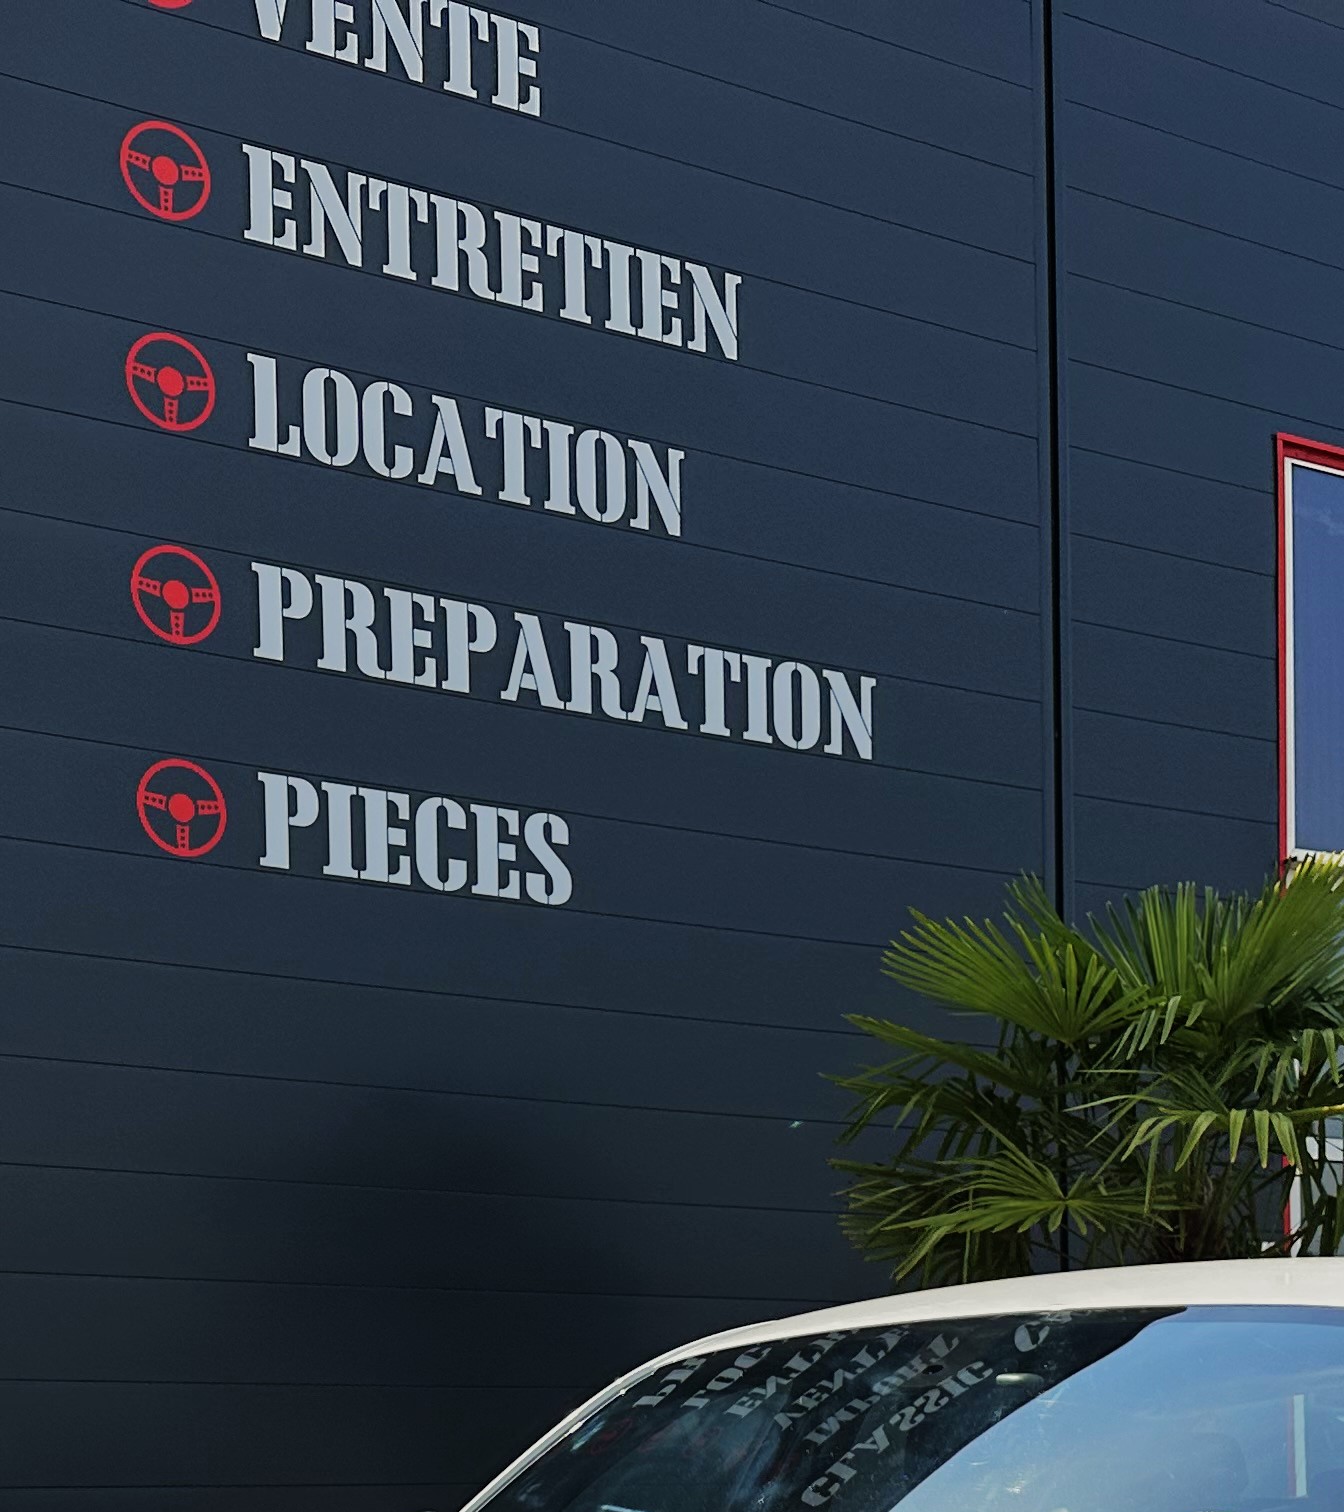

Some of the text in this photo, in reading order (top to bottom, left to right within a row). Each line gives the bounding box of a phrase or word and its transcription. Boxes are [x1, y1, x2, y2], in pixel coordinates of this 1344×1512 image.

[242, 143, 742, 361] ENTRETIEN
[247, 352, 685, 537] LOCATION
[251, 561, 877, 761] PREPARATION
[258, 771, 573, 907] PIECES
